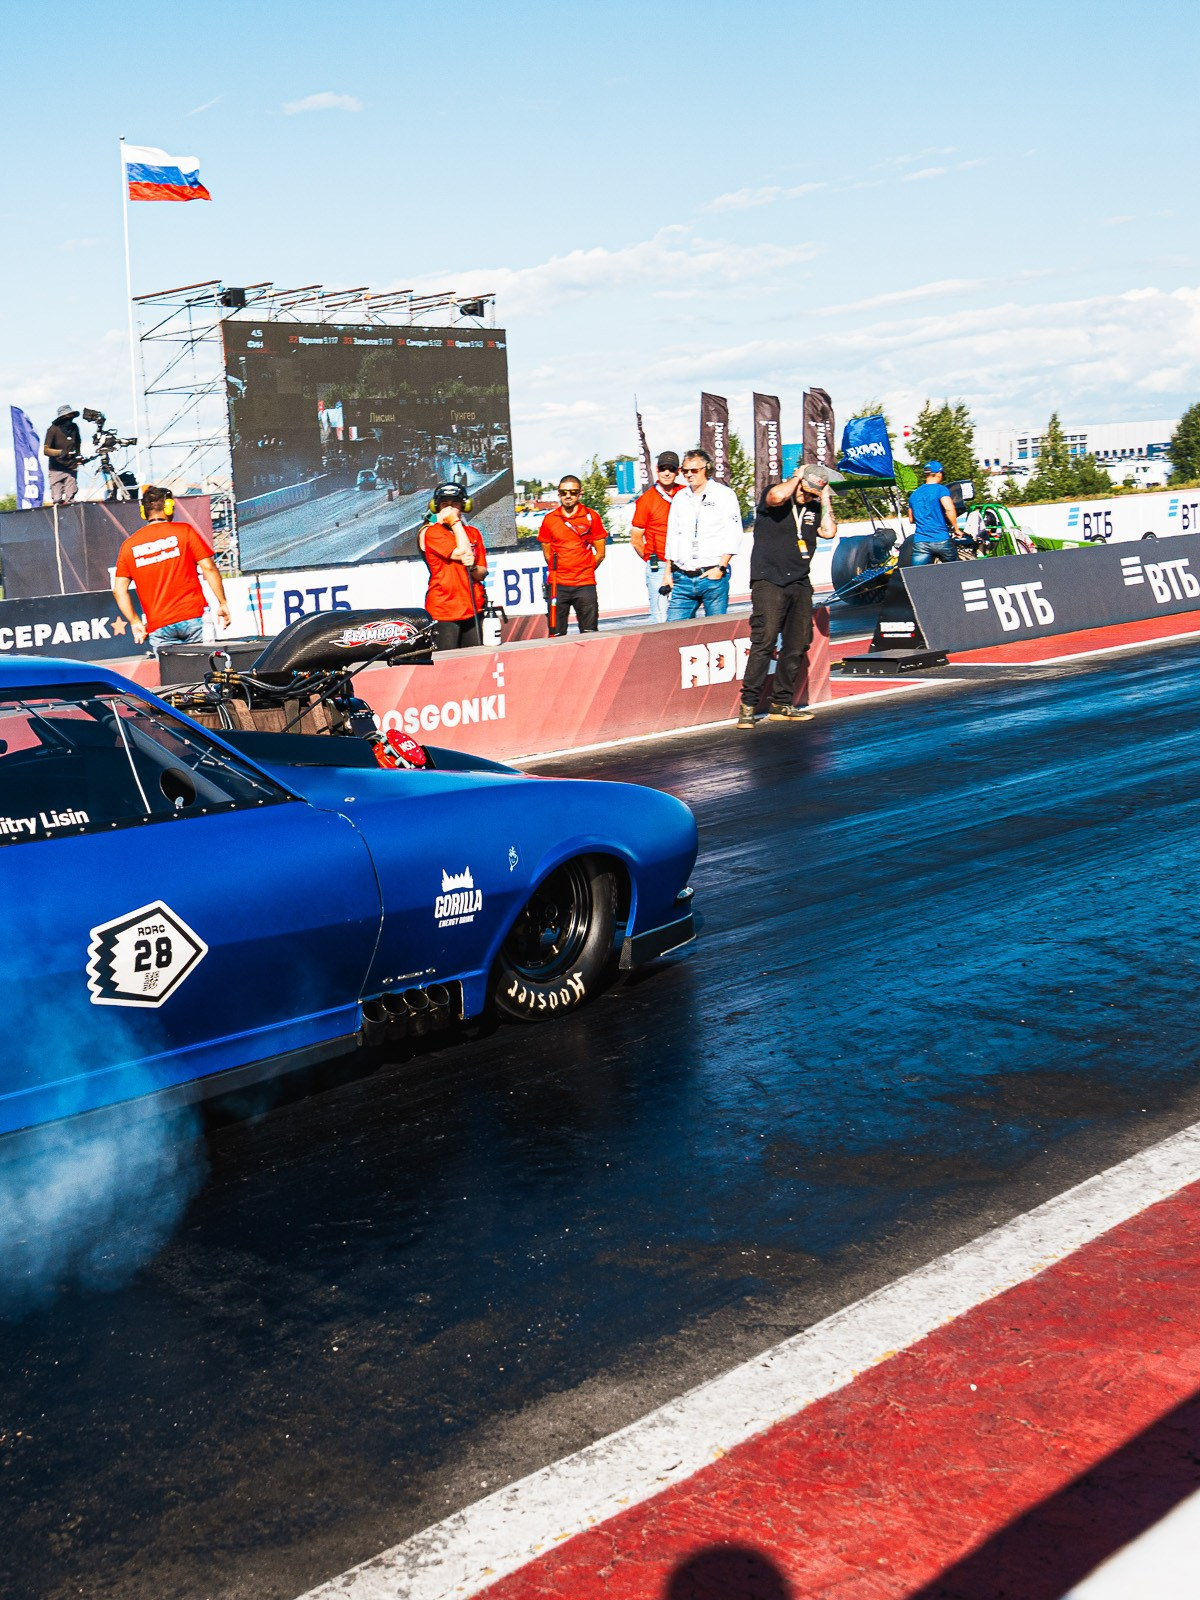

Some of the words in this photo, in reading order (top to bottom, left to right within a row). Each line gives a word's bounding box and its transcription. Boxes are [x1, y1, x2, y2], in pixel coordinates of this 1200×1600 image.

[369, 412, 396, 423] Лисин
[23, 456, 39, 499] ВТБ
[1083, 510, 1113, 541] ВТБ
[1143, 558, 1200, 604] ВТБ
[989, 581, 1055, 632] ВТБ
[678, 633, 783, 690] RD
[39, 808, 90, 829] Lisin
[433, 889, 483, 919] GORILLA
[137, 924, 166, 937] RDRC
[438, 917, 460, 929] ENERGY
[133, 936, 173, 973] 28
[507, 971, 587, 1011] Hoosier
